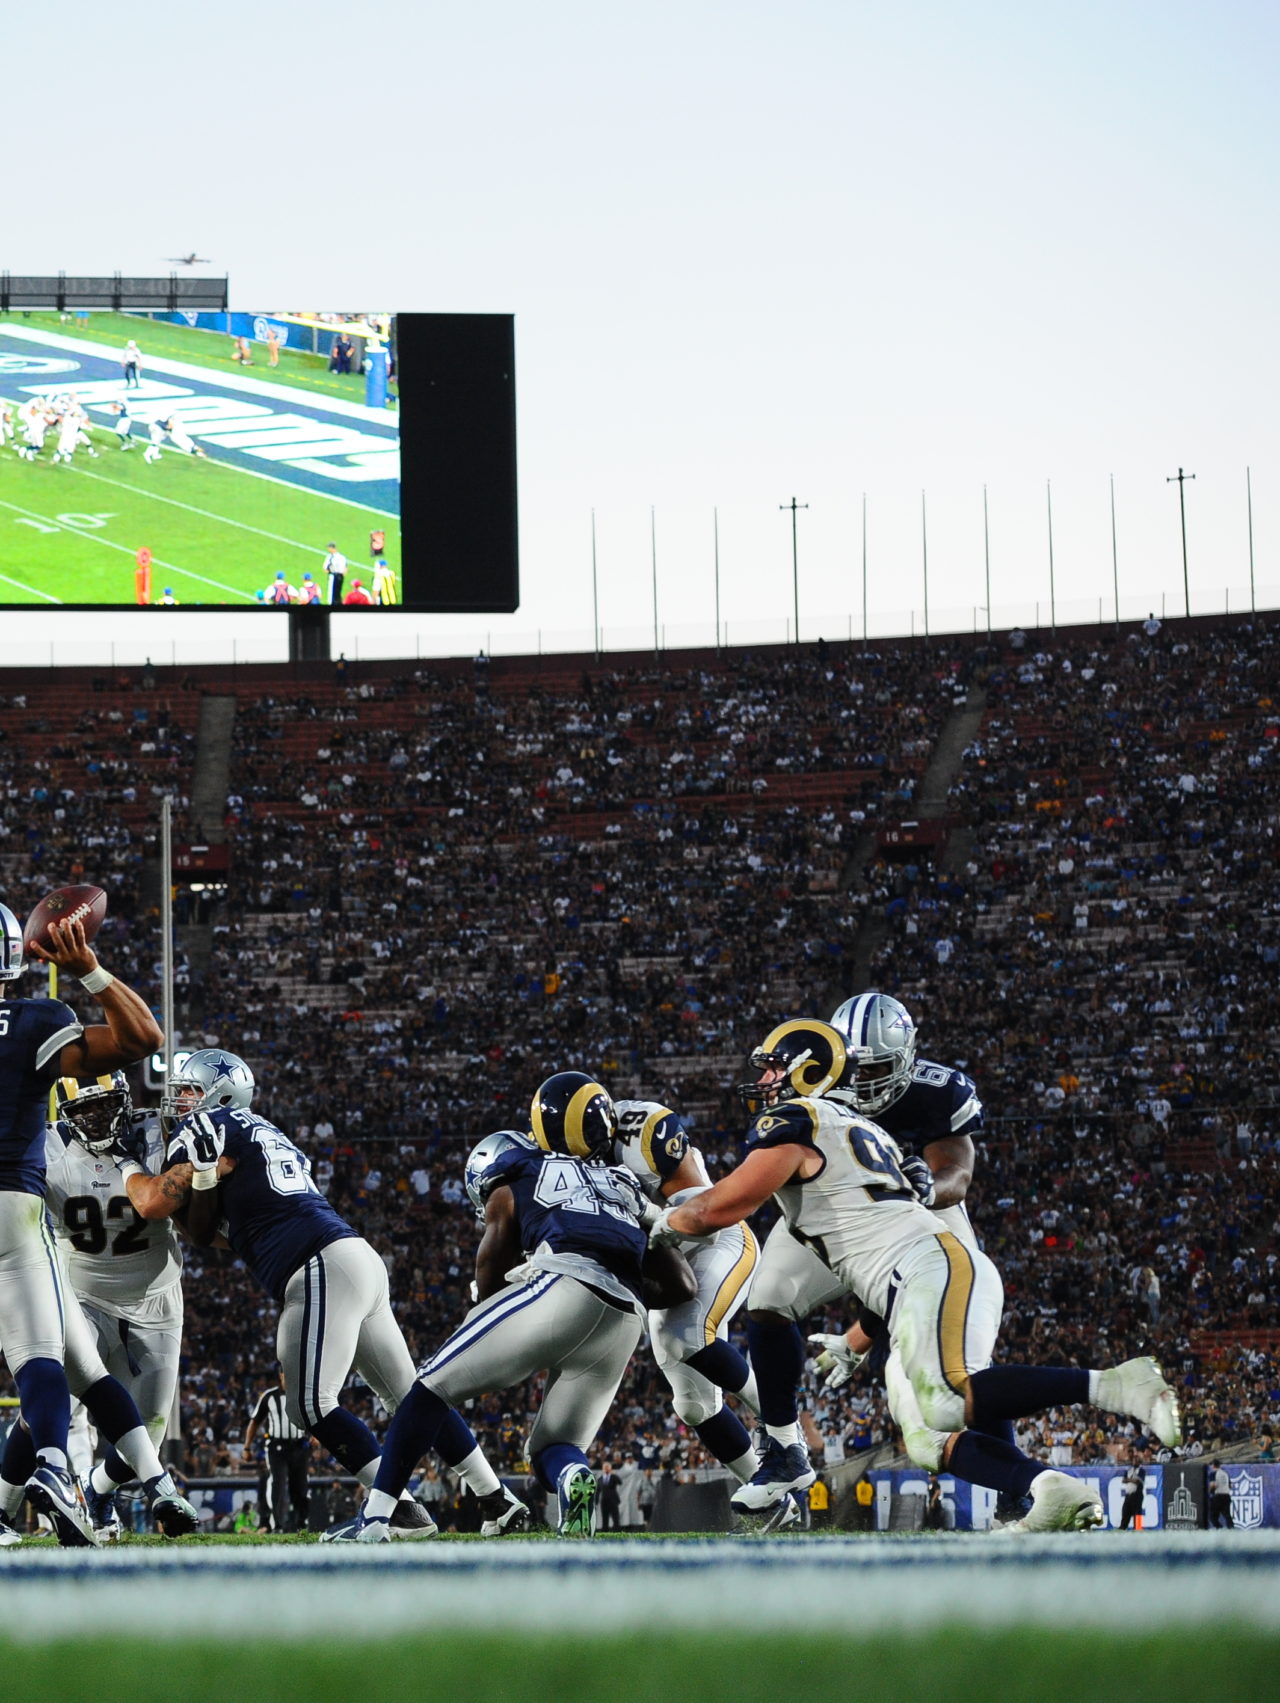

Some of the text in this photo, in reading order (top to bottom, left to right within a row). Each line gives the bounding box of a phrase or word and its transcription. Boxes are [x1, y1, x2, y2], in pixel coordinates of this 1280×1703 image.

[533, 1160, 641, 1229] 45
[63, 1195, 149, 1257] 92
[1232, 1500, 1259, 1521] NFL
